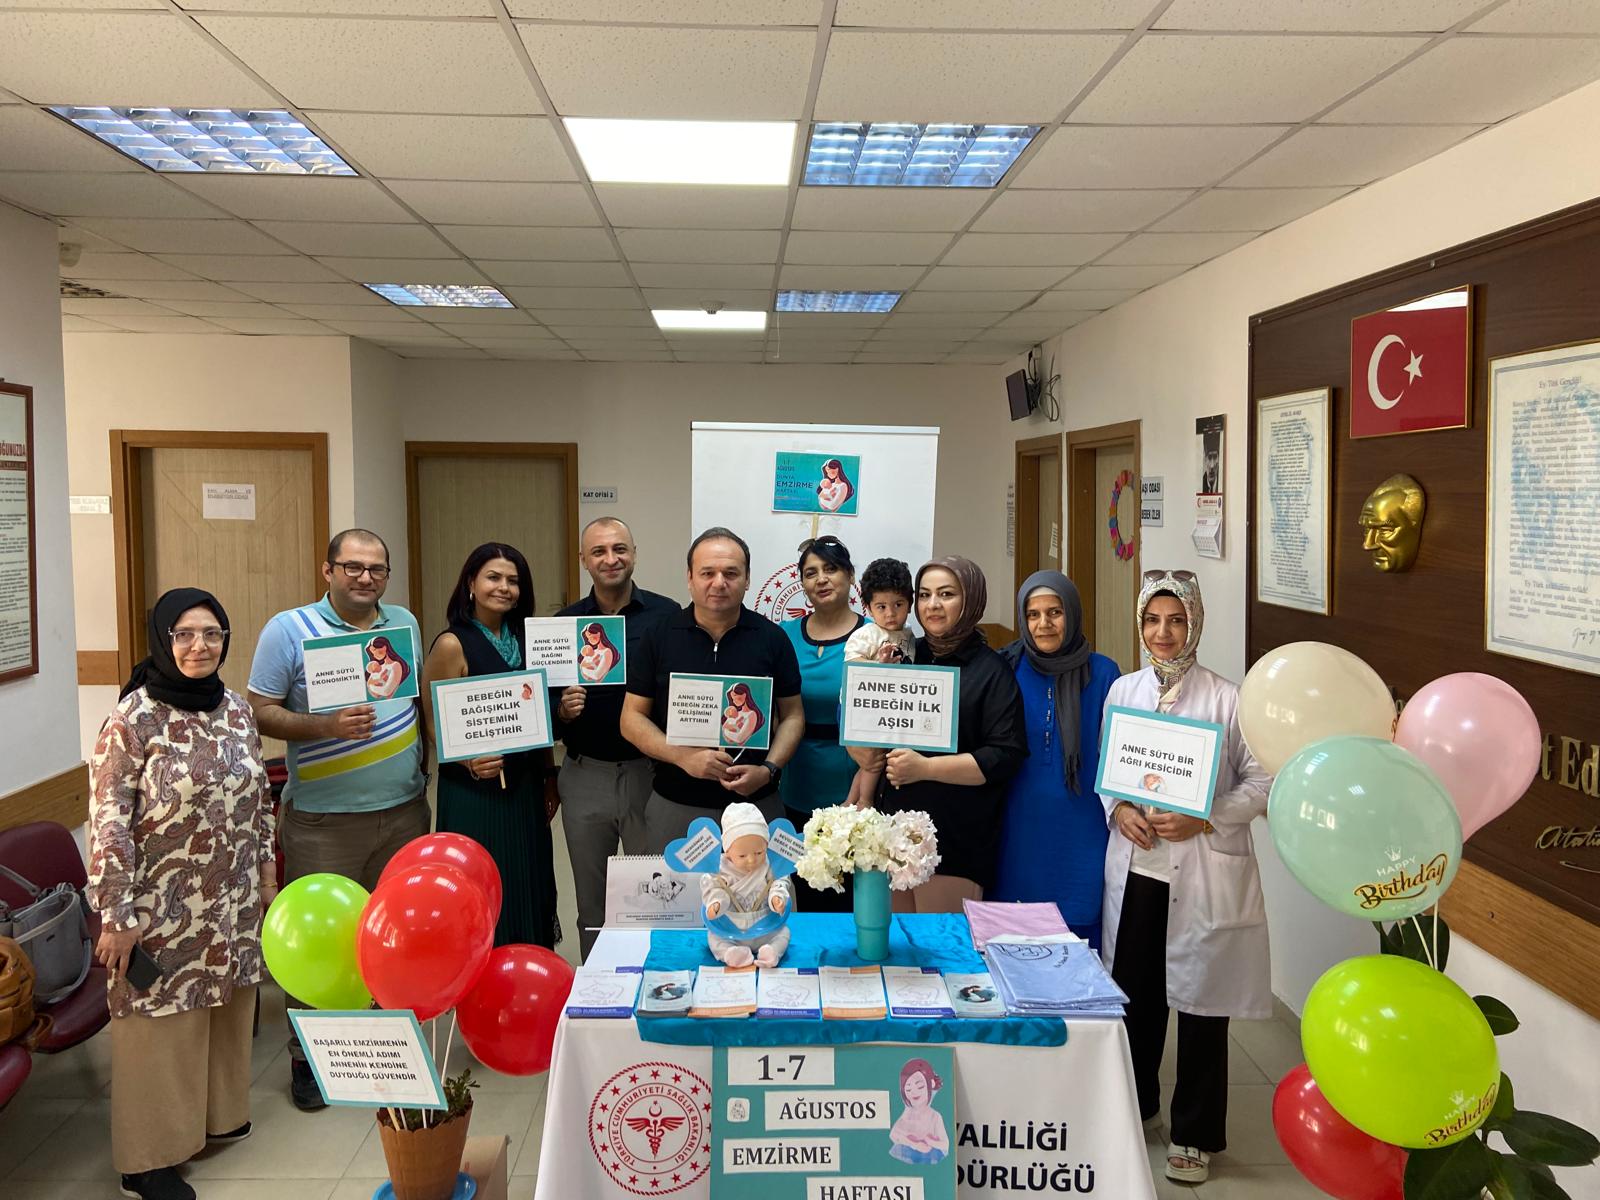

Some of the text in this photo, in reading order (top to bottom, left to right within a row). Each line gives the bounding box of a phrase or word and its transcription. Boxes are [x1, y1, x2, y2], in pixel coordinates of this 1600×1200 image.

[776, 480, 814, 488] EMZİRME
[312, 674, 360, 686] EKONOMİKTİR
[467, 689, 512, 702] BEBEĞİN
[858, 681, 937, 695] ANNE SÜTÜ
[461, 701, 520, 715] BAĞIŞIKLIK
[853, 698, 941, 713] BEBEĞİN İLK
[466, 712, 518, 727] SİSTEMİNİ
[878, 716, 914, 729] AŞISI
[465, 724, 522, 739] GELİŞTİRİR
[1121, 744, 1194, 765] ANNE SÜTÜ BİR
[1120, 756, 1192, 778] AĞRI KESİCİDİR
[1376, 856, 1416, 876] HAPPY
[1354, 854, 1447, 910] Birthday
[313, 1038, 408, 1047] BAŞARILI EMZİRMENİN
[342, 1050, 374, 1058] ÖNEMLİ
[757, 1054, 806, 1081] 1-7
[330, 1071, 417, 1080] DUYDUĞU GÜVENDİR
[779, 1097, 876, 1120] AĞUSTOS
[1424, 1082, 1496, 1145] Birthday
[612, 1086, 699, 1166] TÜRKİYE CUMHURİYETİ SAĞLIK BAKANLIĞI
[732, 1143, 832, 1165] EMZİRME
[820, 1186, 911, 1200] HAFTASI
